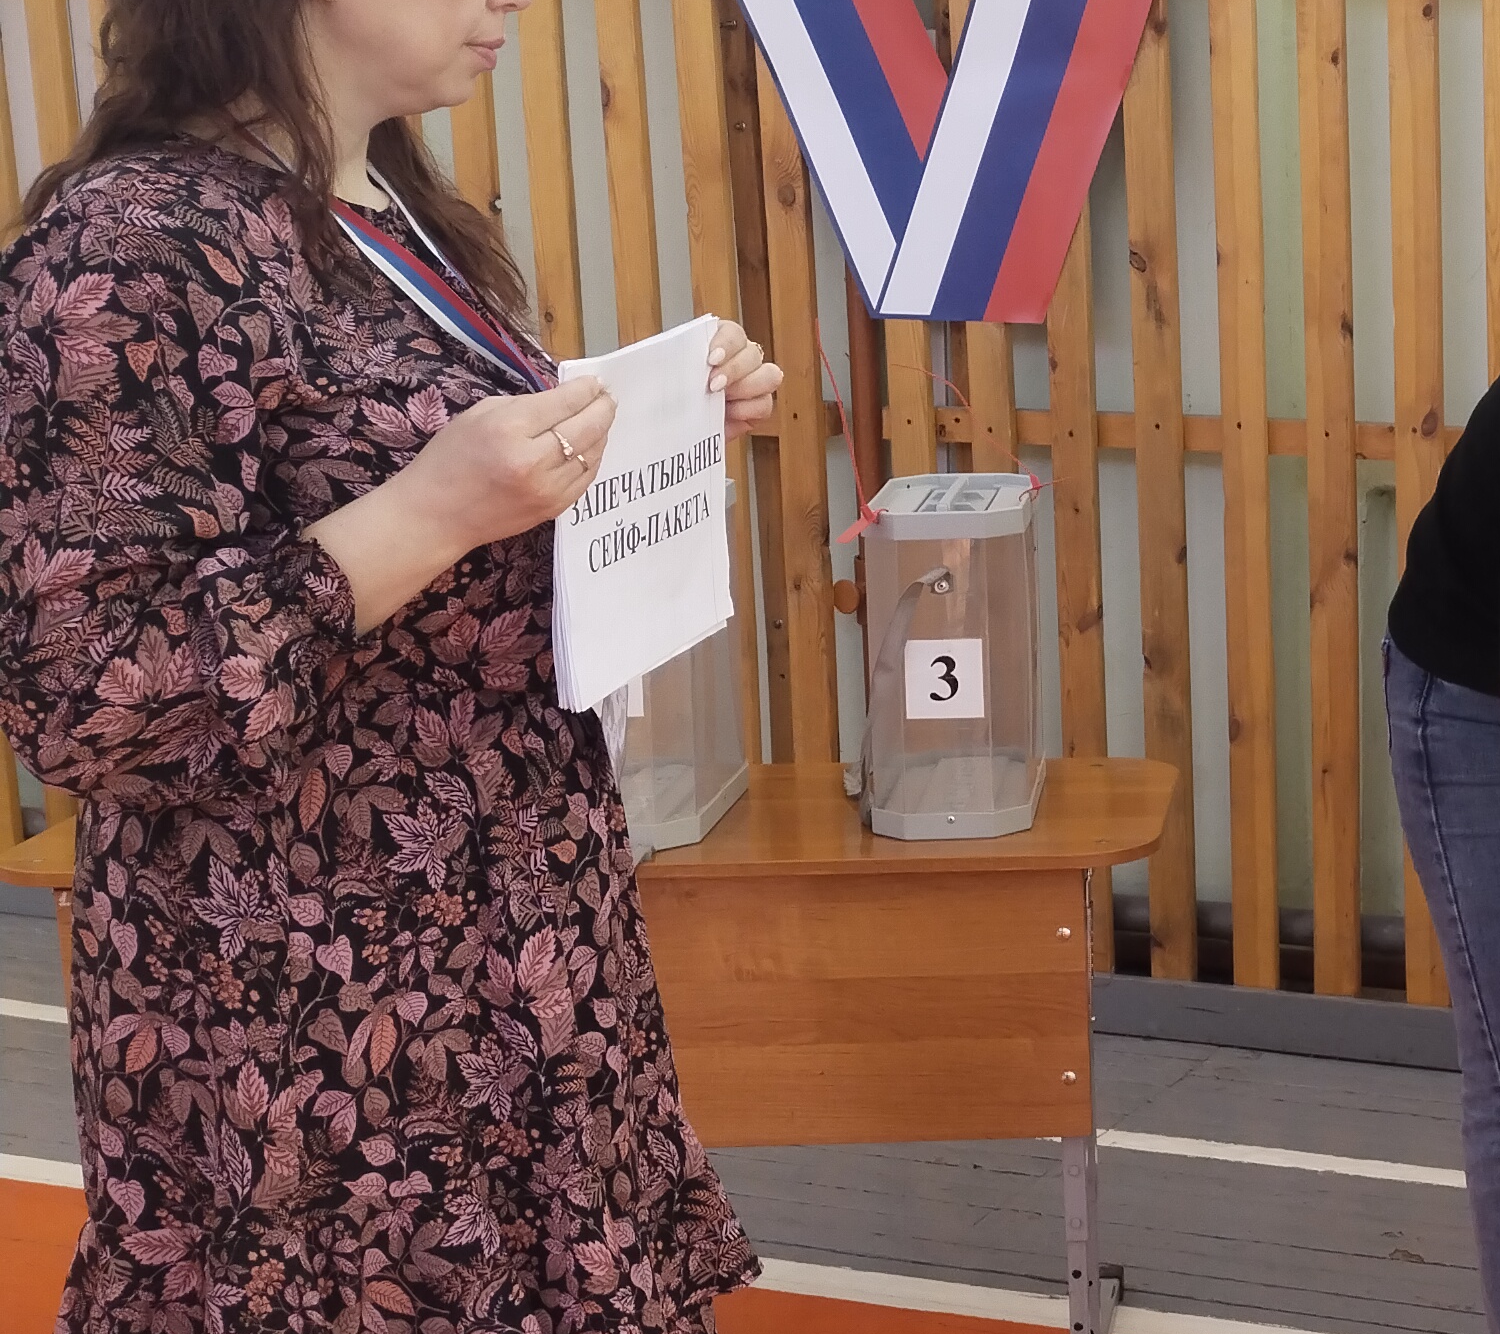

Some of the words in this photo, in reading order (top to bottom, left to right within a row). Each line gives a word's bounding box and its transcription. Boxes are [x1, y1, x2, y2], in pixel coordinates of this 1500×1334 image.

[570, 432, 722, 527] ЗАПЕЧАТЫВАНИЕ
[588, 490, 711, 574] СЕЙФ-ПАКЕТА
[929, 655, 959, 701] 3
